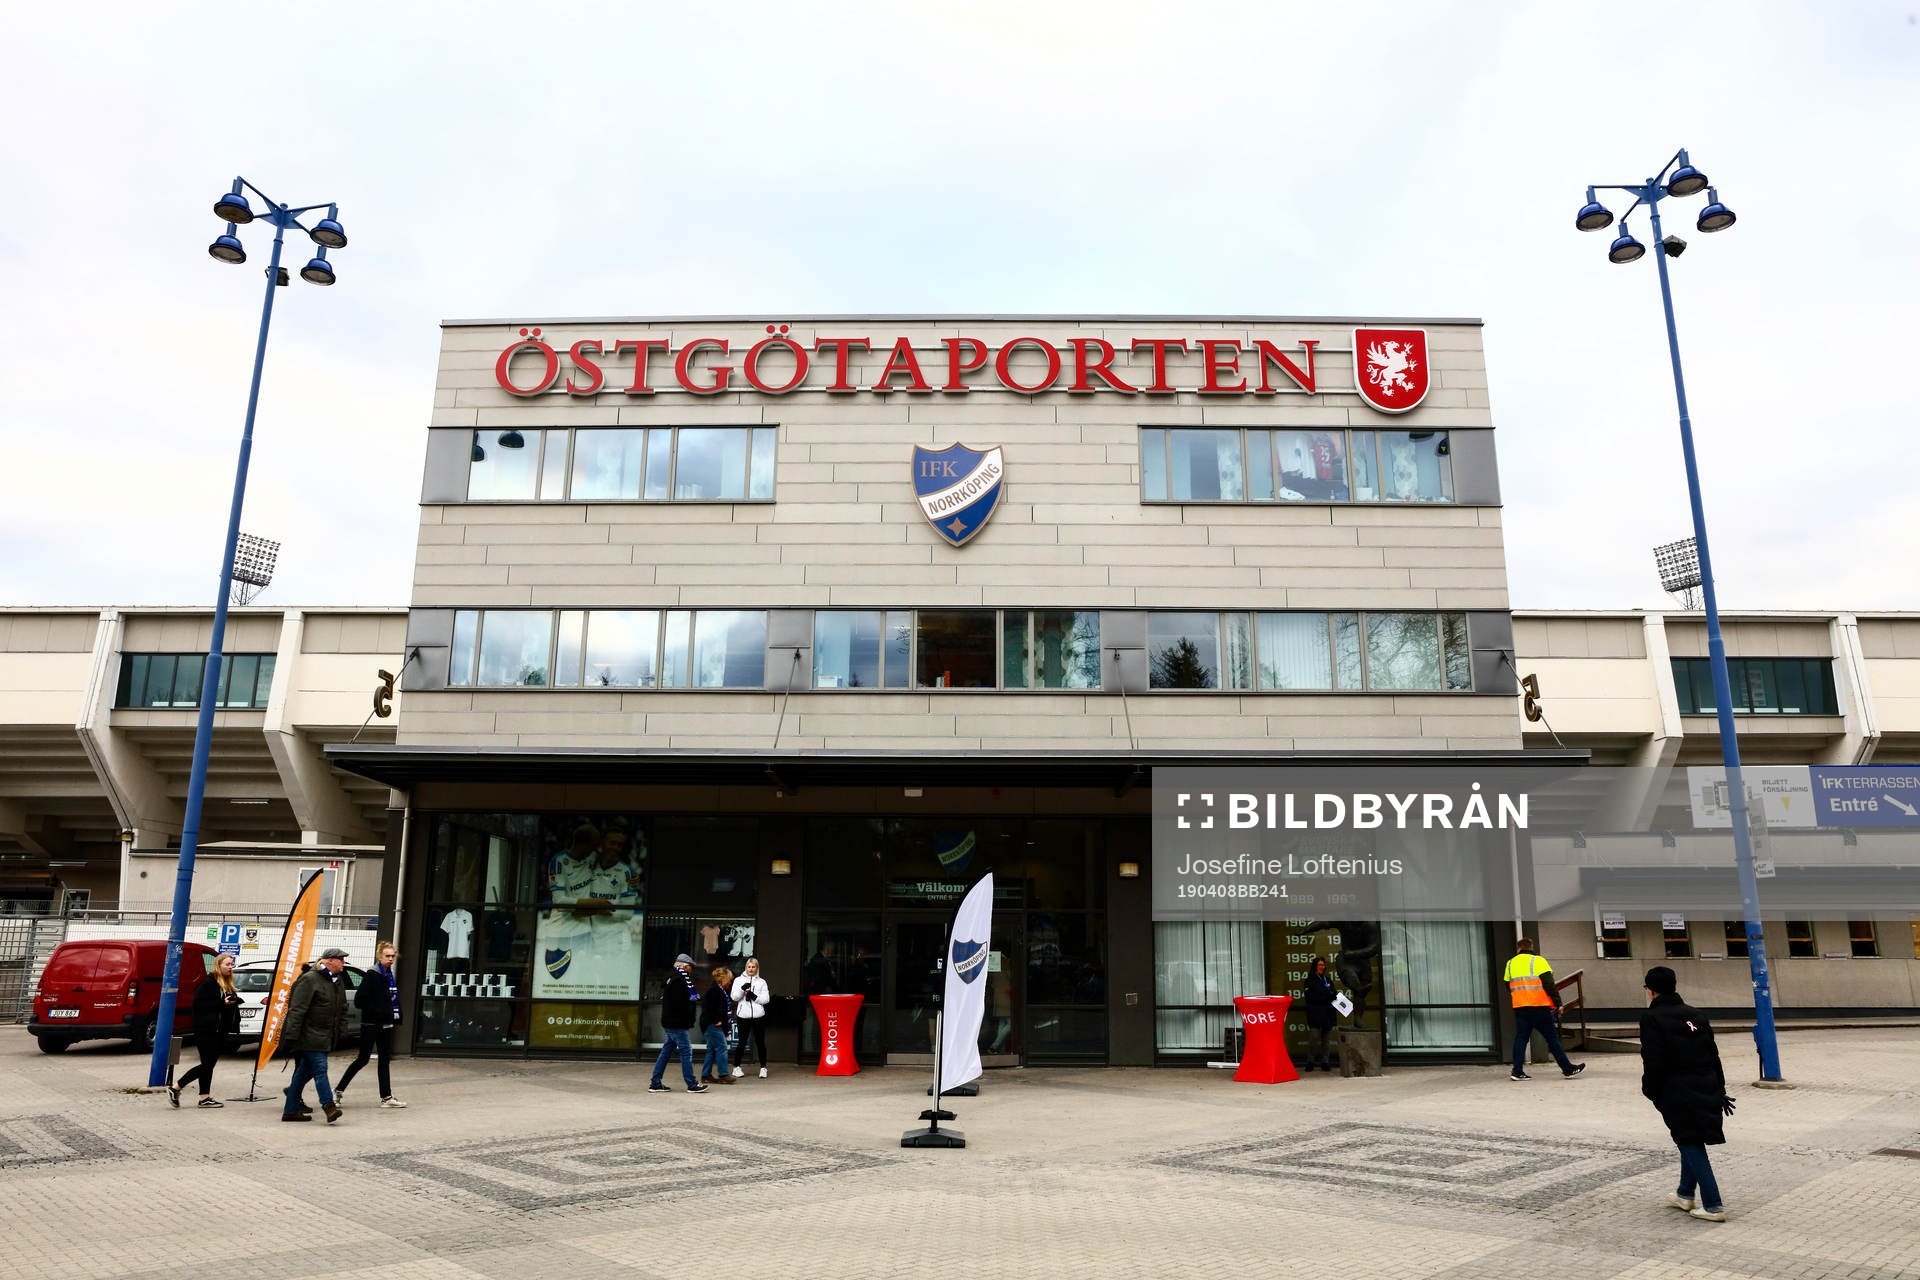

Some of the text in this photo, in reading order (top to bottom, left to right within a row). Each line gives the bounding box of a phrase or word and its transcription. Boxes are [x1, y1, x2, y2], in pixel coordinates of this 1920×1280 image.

[495, 324, 1321, 397] ÖSTGÖTAPORTEN
[920, 460, 959, 478] IFK
[928, 463, 1000, 515] NORRKÖPING
[1830, 797, 1878, 812] Entré
[225, 926, 237, 942] P
[1286, 935, 1315, 945] 1957
[267, 1016, 279, 1043] DU
[274, 988, 289, 1014] ÄR
[282, 920, 305, 985] HEMMA
[827, 1011, 838, 1051] MORE
